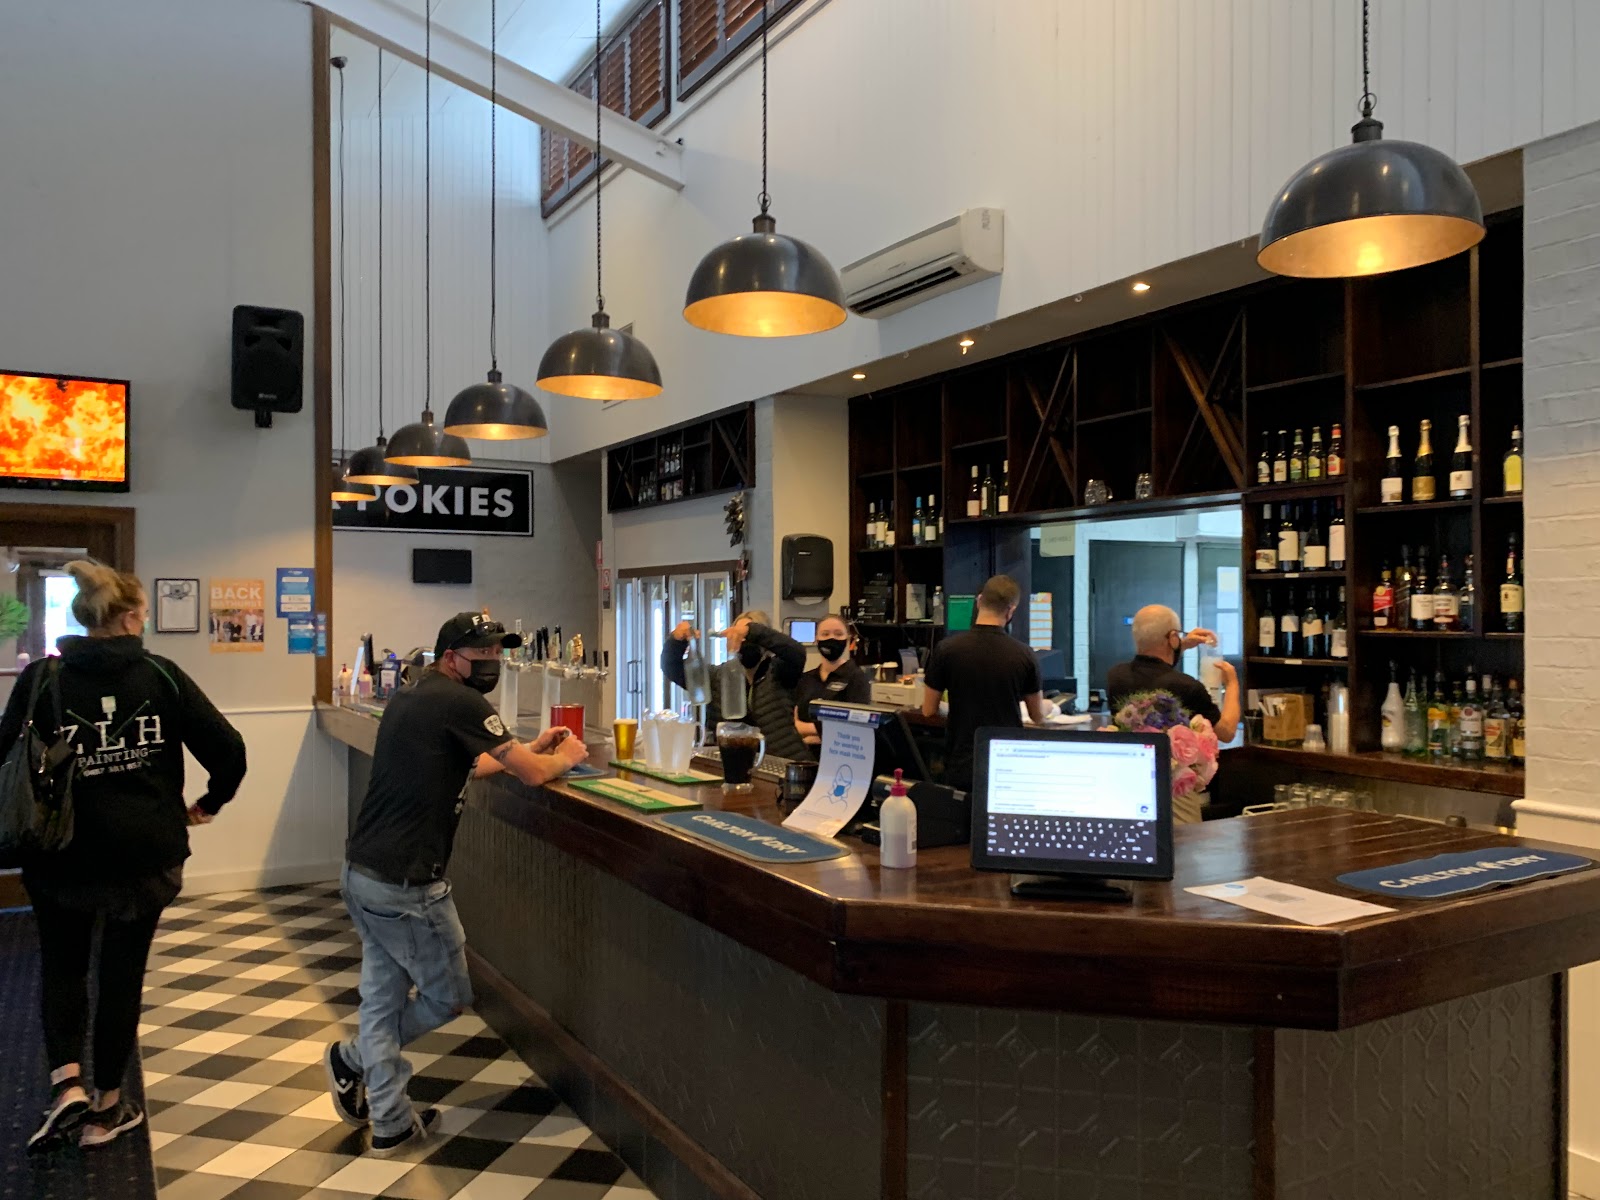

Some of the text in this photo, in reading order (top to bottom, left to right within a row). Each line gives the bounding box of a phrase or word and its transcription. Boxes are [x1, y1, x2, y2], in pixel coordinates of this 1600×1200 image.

[356, 483, 514, 518] POKIES
[211, 587, 262, 600] BACK
[837, 731, 850, 739] Thank
[77, 747, 149, 768] PAINTING
[841, 743, 860, 752] wearing
[691, 815, 808, 854] CARLTON DRY
[1378, 854, 1548, 890] CARLTON DRY
